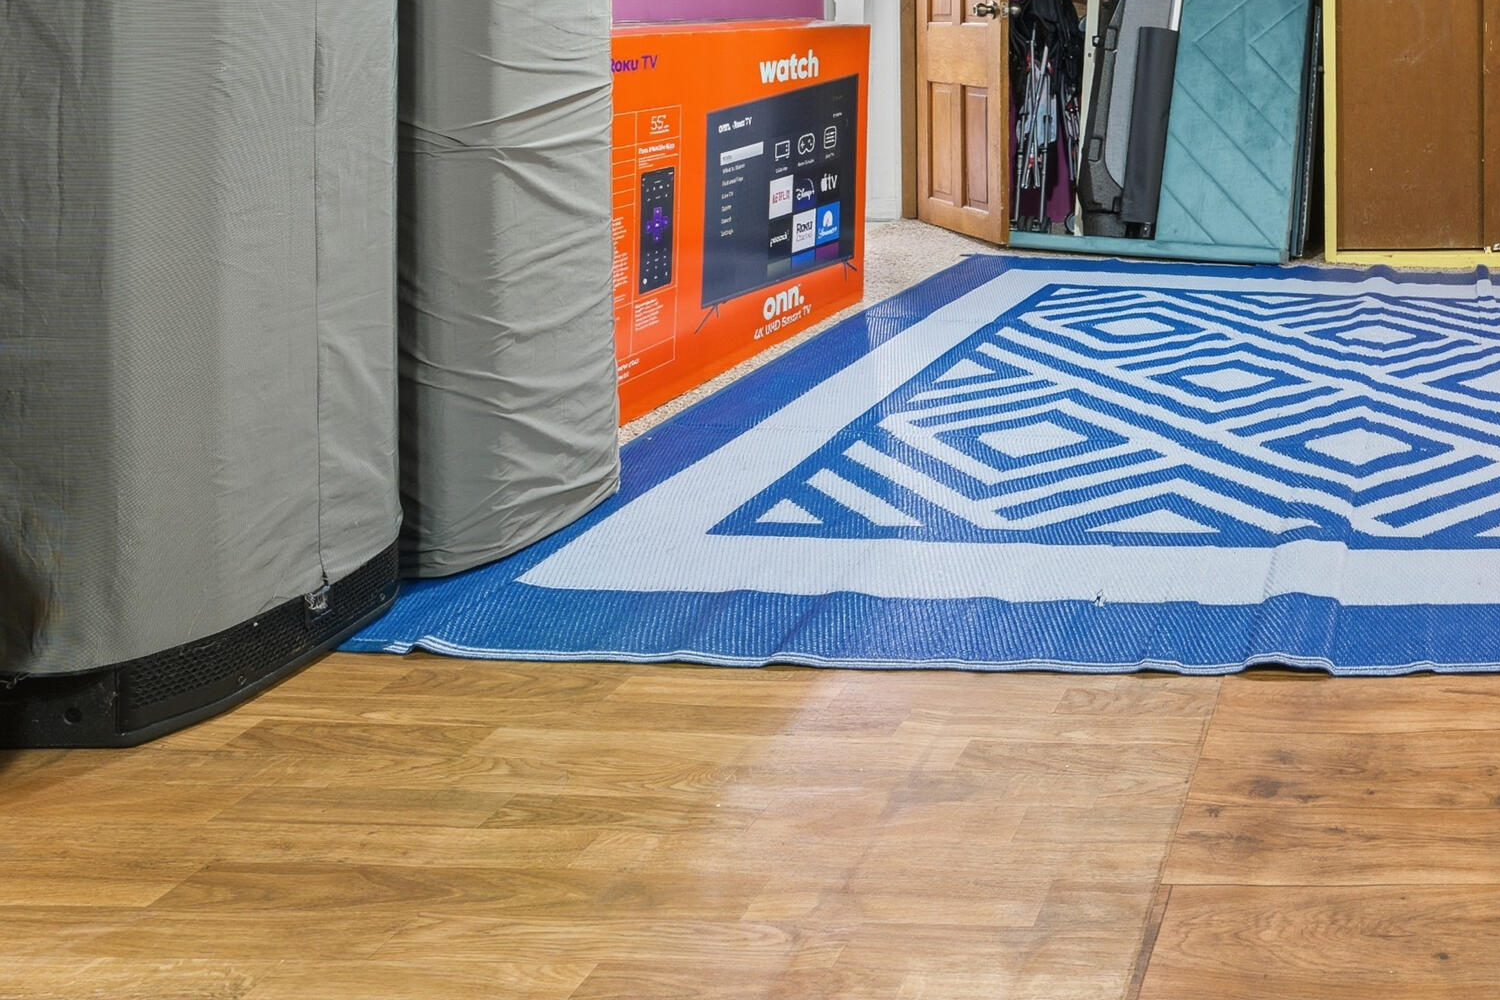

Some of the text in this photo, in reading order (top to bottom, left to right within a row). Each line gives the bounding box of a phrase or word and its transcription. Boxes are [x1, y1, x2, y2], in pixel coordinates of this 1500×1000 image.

[641, 55, 658, 69] TV
[759, 49, 819, 84] watch
[763, 286, 805, 320] onn.
[781, 309, 802, 328] Smart
[802, 303, 812, 316] TV
